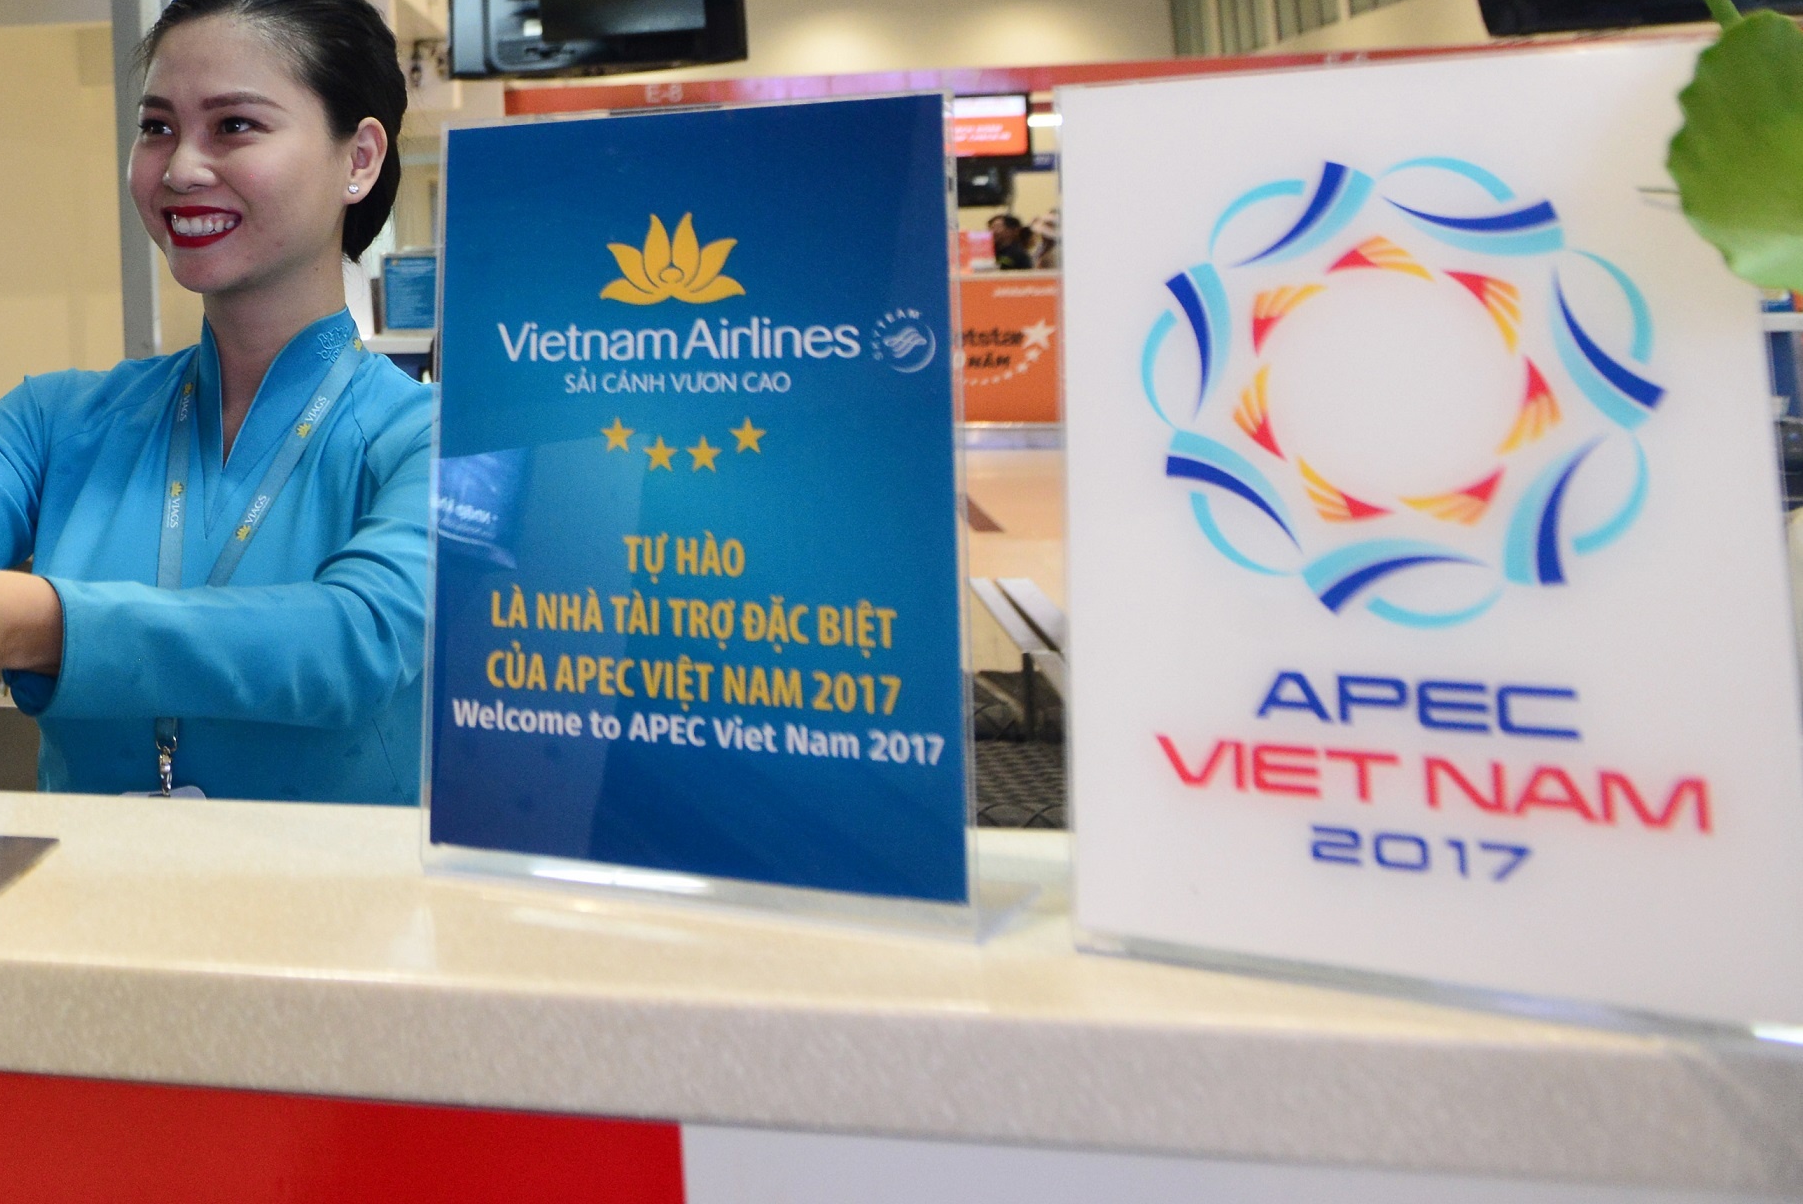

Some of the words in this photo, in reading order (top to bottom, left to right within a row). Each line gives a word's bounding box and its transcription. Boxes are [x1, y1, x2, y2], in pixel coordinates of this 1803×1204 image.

[497, 321, 679, 363] Vietnam
[682, 316, 862, 360] Airlines
[742, 370, 792, 394] CAO
[622, 531, 670, 585] TỰ
[676, 529, 746, 578] HÀO
[490, 583, 529, 630] LÀ
[536, 586, 604, 634] NHÀ
[609, 588, 660, 637] TÀI
[667, 598, 737, 651] TRỢ
[740, 594, 810, 655] ĐẶC
[816, 598, 898, 659] BIỆT
[486, 639, 548, 692] CỦA
[554, 653, 636, 698] APEC
[640, 653, 715, 713] VIỆT
[722, 664, 804, 710] NAM
[811, 670, 902, 717] 2017
[1256, 670, 1581, 741] APEC
[452, 698, 583, 738] Welcome
[589, 708, 622, 741] to
[628, 711, 707, 748] APEC
[712, 714, 779, 754] Viet
[784, 722, 861, 760] Nam
[868, 728, 945, 766] 2017
[1155, 733, 1400, 804] VIET
[1422, 756, 1715, 836] NAM
[1309, 824, 1534, 882] 2017
